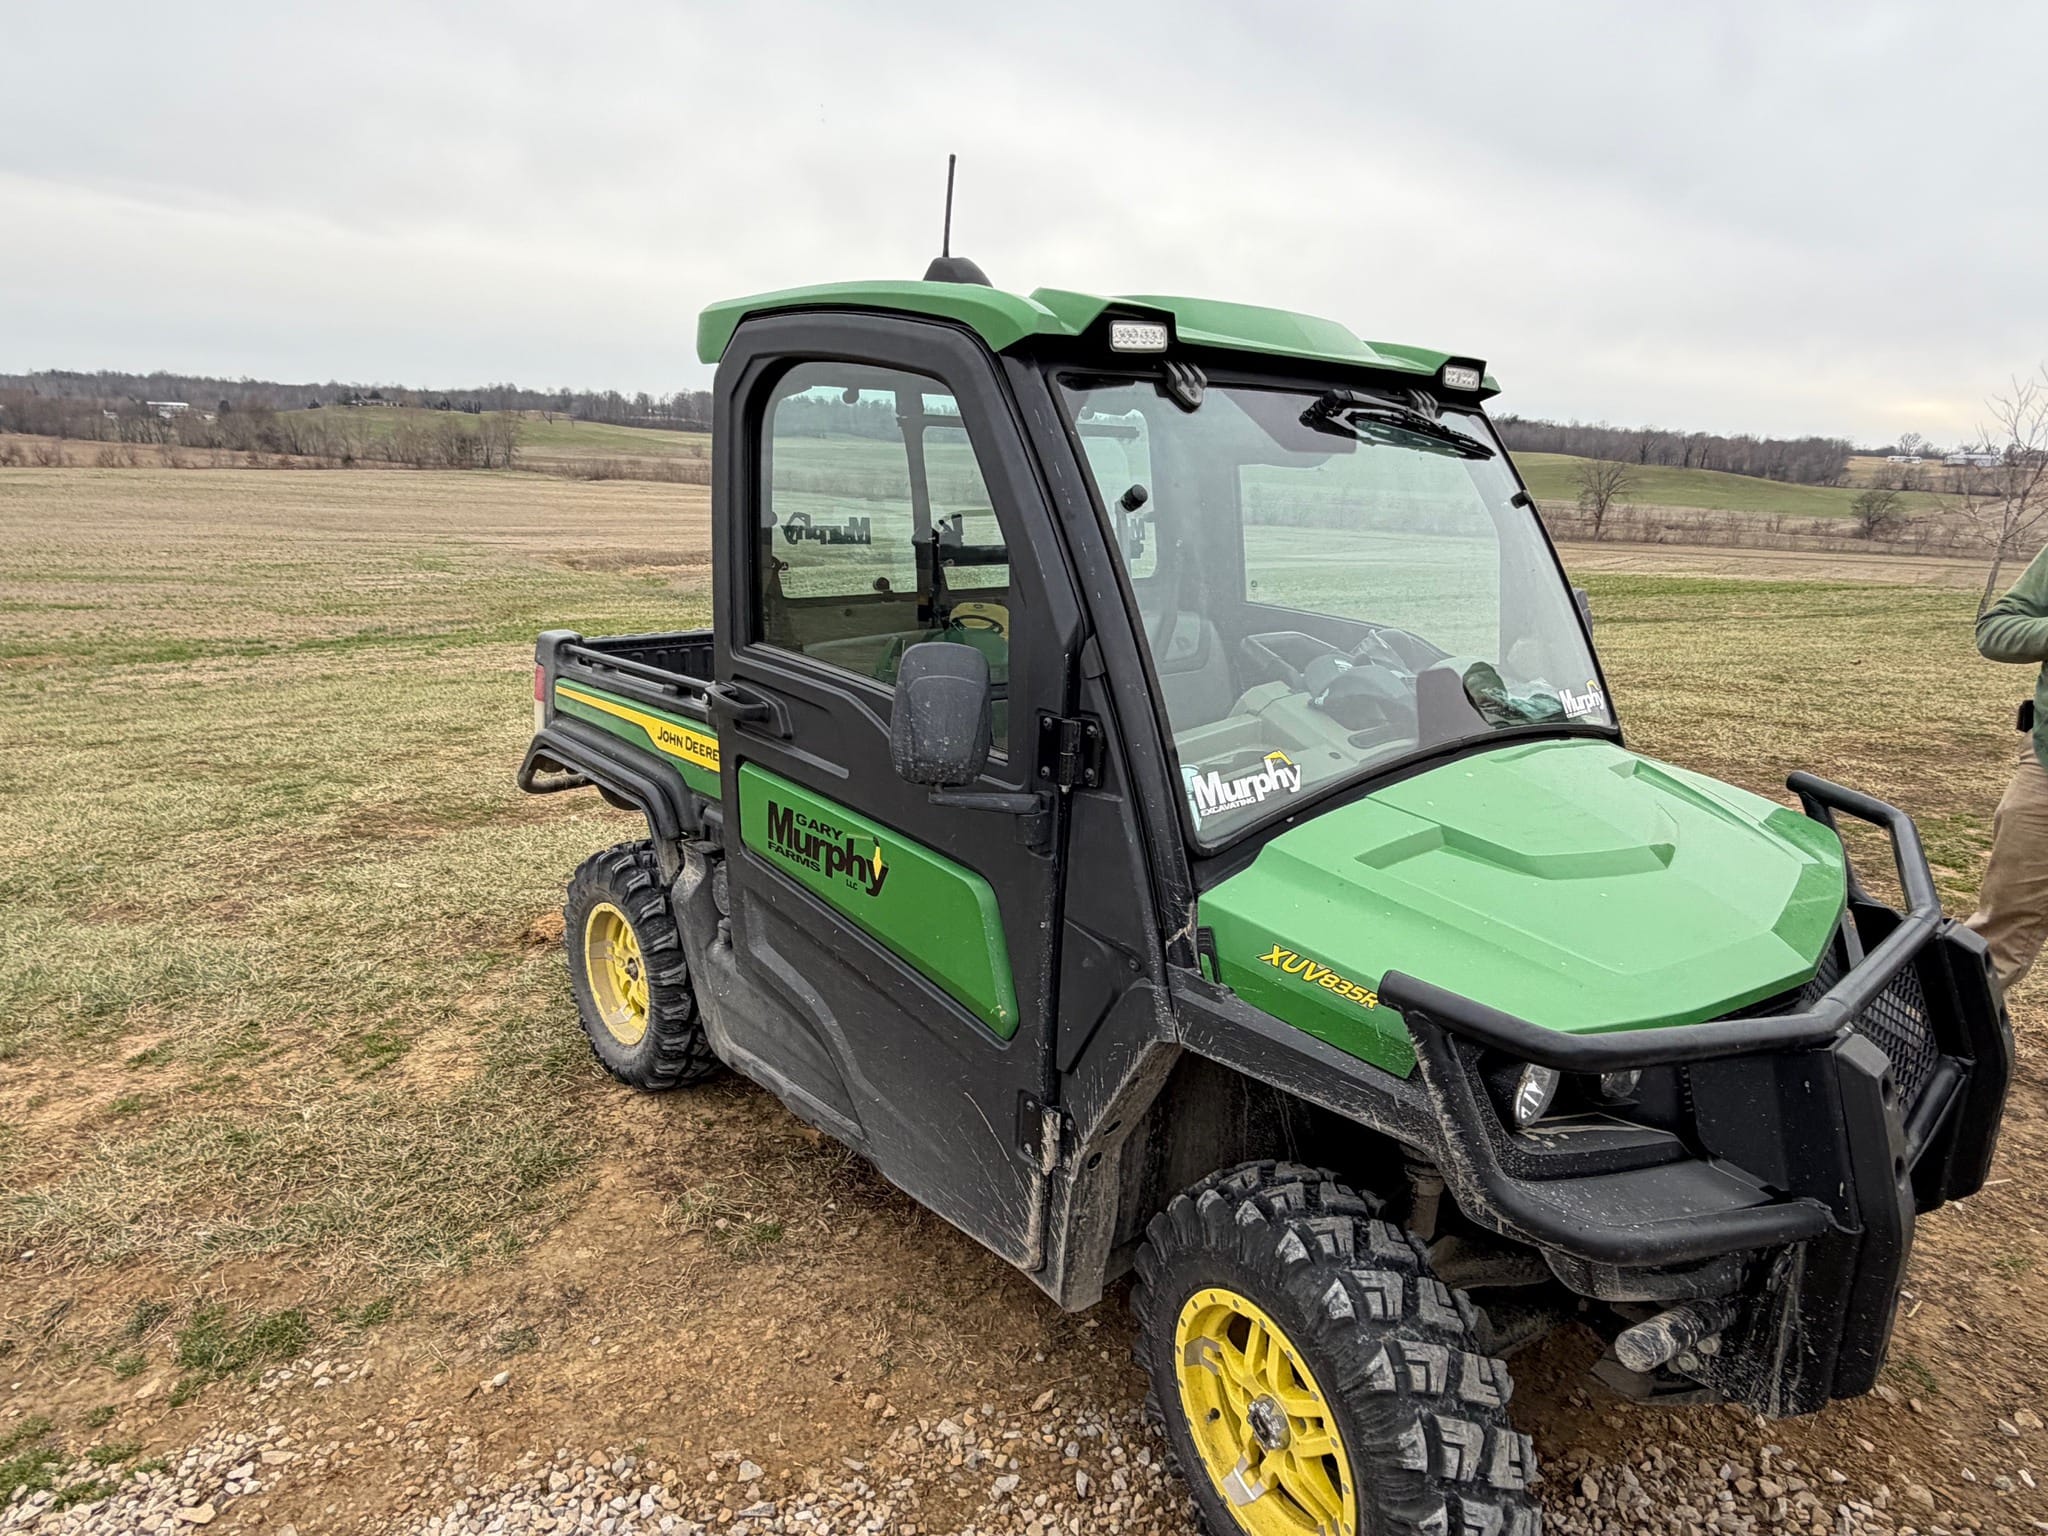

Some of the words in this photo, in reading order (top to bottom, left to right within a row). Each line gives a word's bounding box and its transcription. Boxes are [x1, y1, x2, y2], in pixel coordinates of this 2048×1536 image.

[1559, 681, 1604, 714] Murphy
[657, 726, 684, 748] JOHN
[685, 735, 720, 762] DEERE
[1191, 756, 1301, 810] Murphy
[1200, 796, 1257, 817] EXCAVATING
[795, 813, 844, 841] GARY
[767, 799, 890, 897] Murphy
[767, 840, 822, 873] FARMS
[845, 878, 859, 890] LLC
[1256, 943, 1380, 1011] XUV835R
